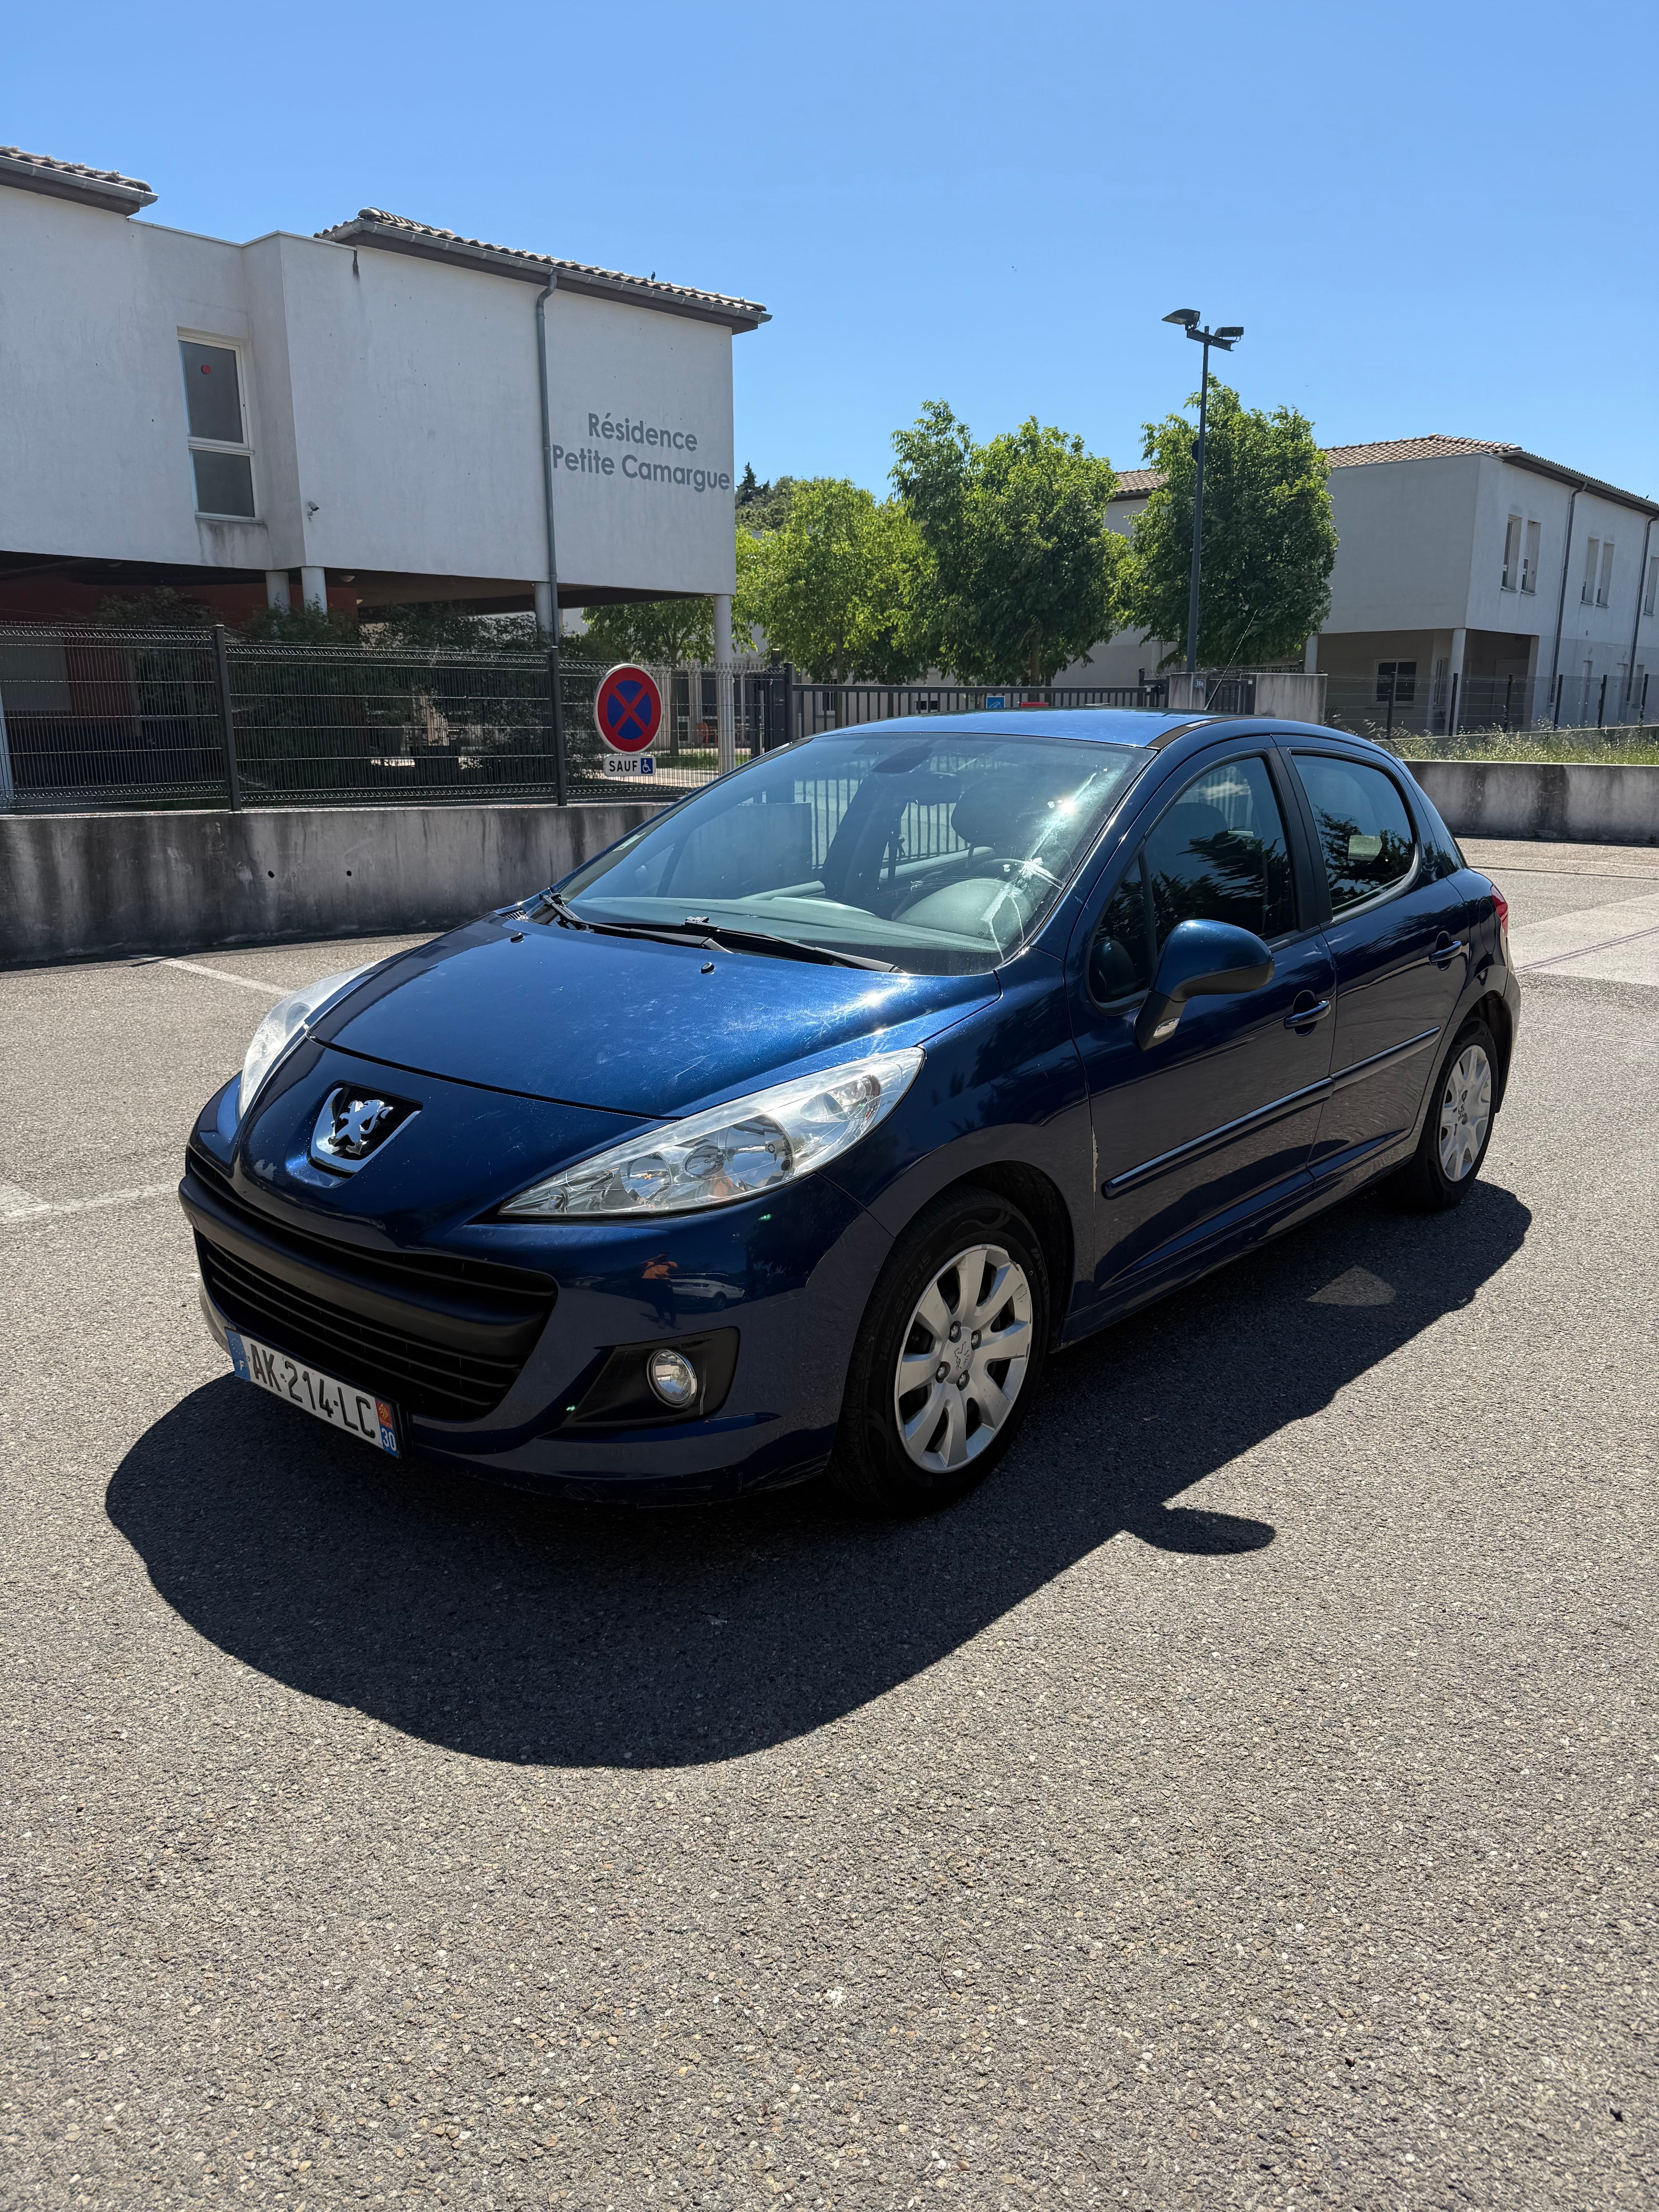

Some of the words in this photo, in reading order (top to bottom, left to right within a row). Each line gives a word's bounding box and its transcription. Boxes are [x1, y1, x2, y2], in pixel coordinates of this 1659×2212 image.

[588, 412, 698, 452] Résidence
[552, 444, 615, 476] Petite
[622, 454, 730, 493] Camargue
[609, 760, 638, 772] SAUF
[239, 1360, 245, 1370] F
[250, 1343, 376, 1439] AK-214-LC
[381, 1428, 397, 1451] 30
